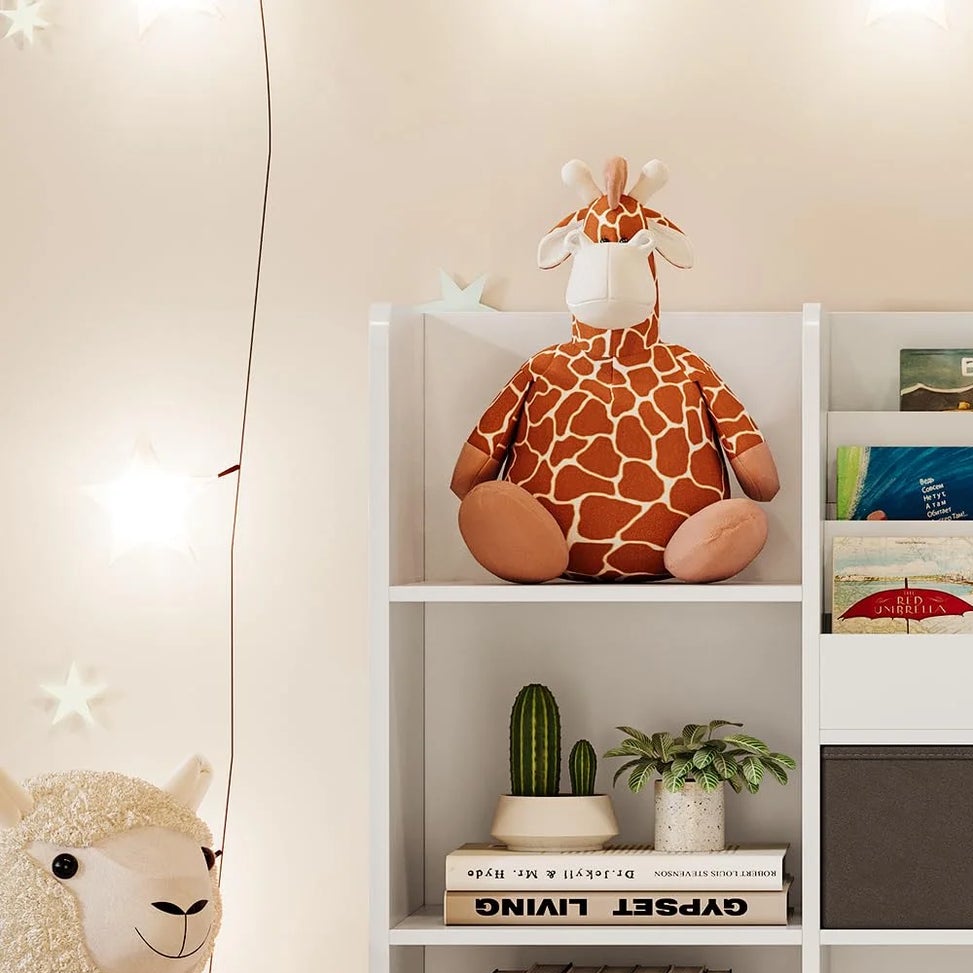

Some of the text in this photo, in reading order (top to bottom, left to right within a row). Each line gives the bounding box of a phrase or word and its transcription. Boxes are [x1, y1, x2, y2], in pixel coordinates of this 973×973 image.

[897, 596, 923, 606] RED
[874, 605, 946, 615] UMBRELLA
[513, 869, 538, 880] Mr.
[546, 870, 556, 879] &
[475, 898, 748, 917] GYPSET LIVING
